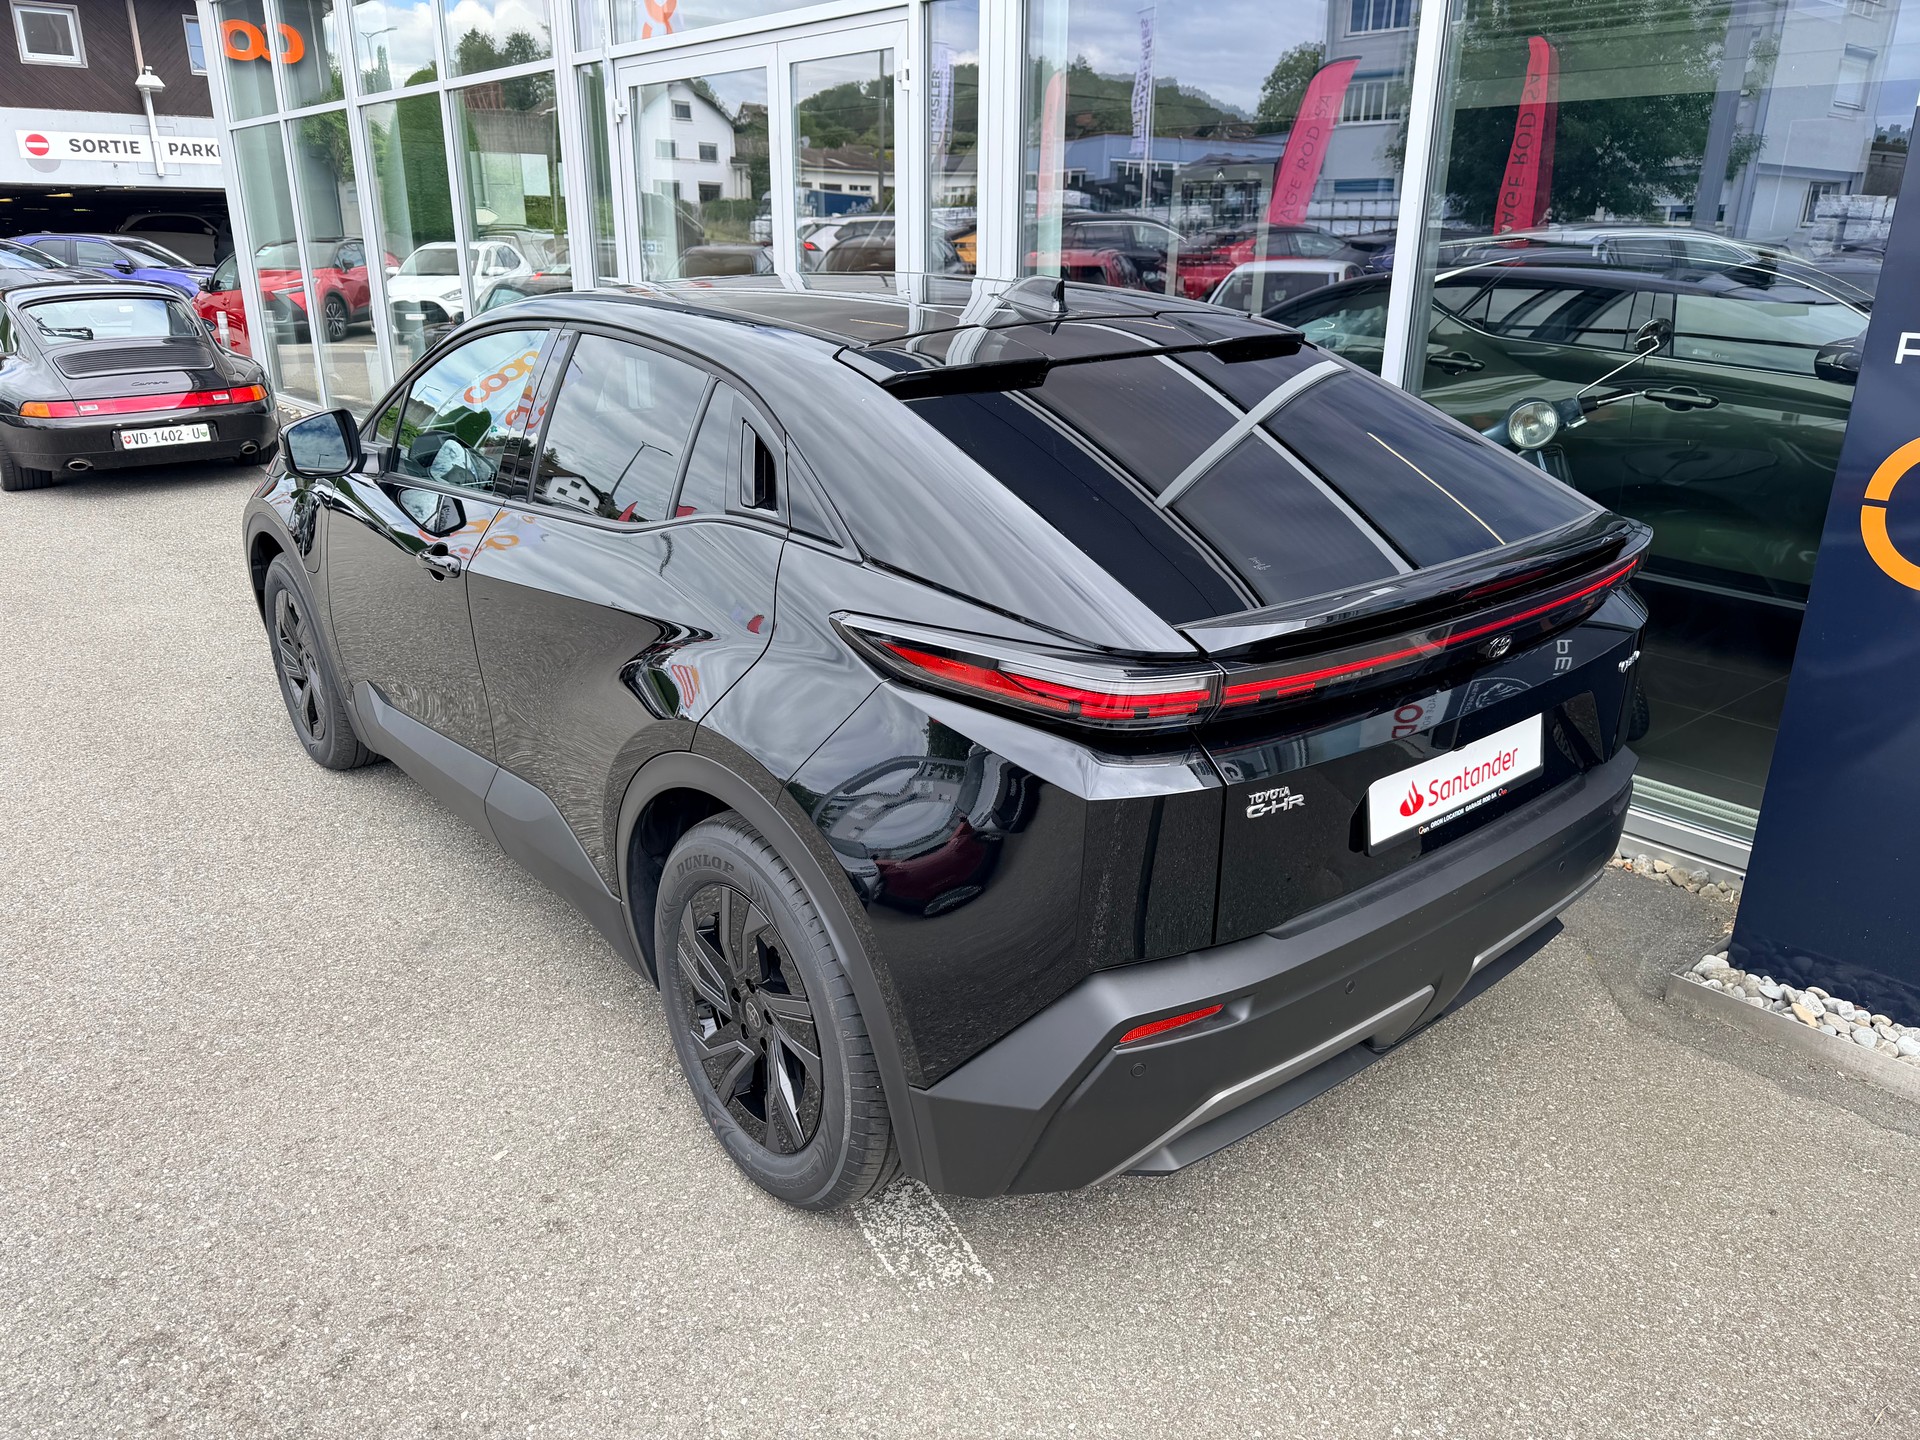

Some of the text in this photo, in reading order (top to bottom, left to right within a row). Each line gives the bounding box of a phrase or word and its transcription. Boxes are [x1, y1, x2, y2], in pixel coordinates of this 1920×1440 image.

[68, 138, 141, 154] SORTIE
[1297, 125, 1321, 172] ROD
[1428, 748, 1518, 807] Santander
[1247, 794, 1305, 818] C-HR
[1248, 786, 1290, 804] TOYOTA
[1443, 808, 1465, 822] LOCATION
[677, 854, 735, 876] DUNLOP
